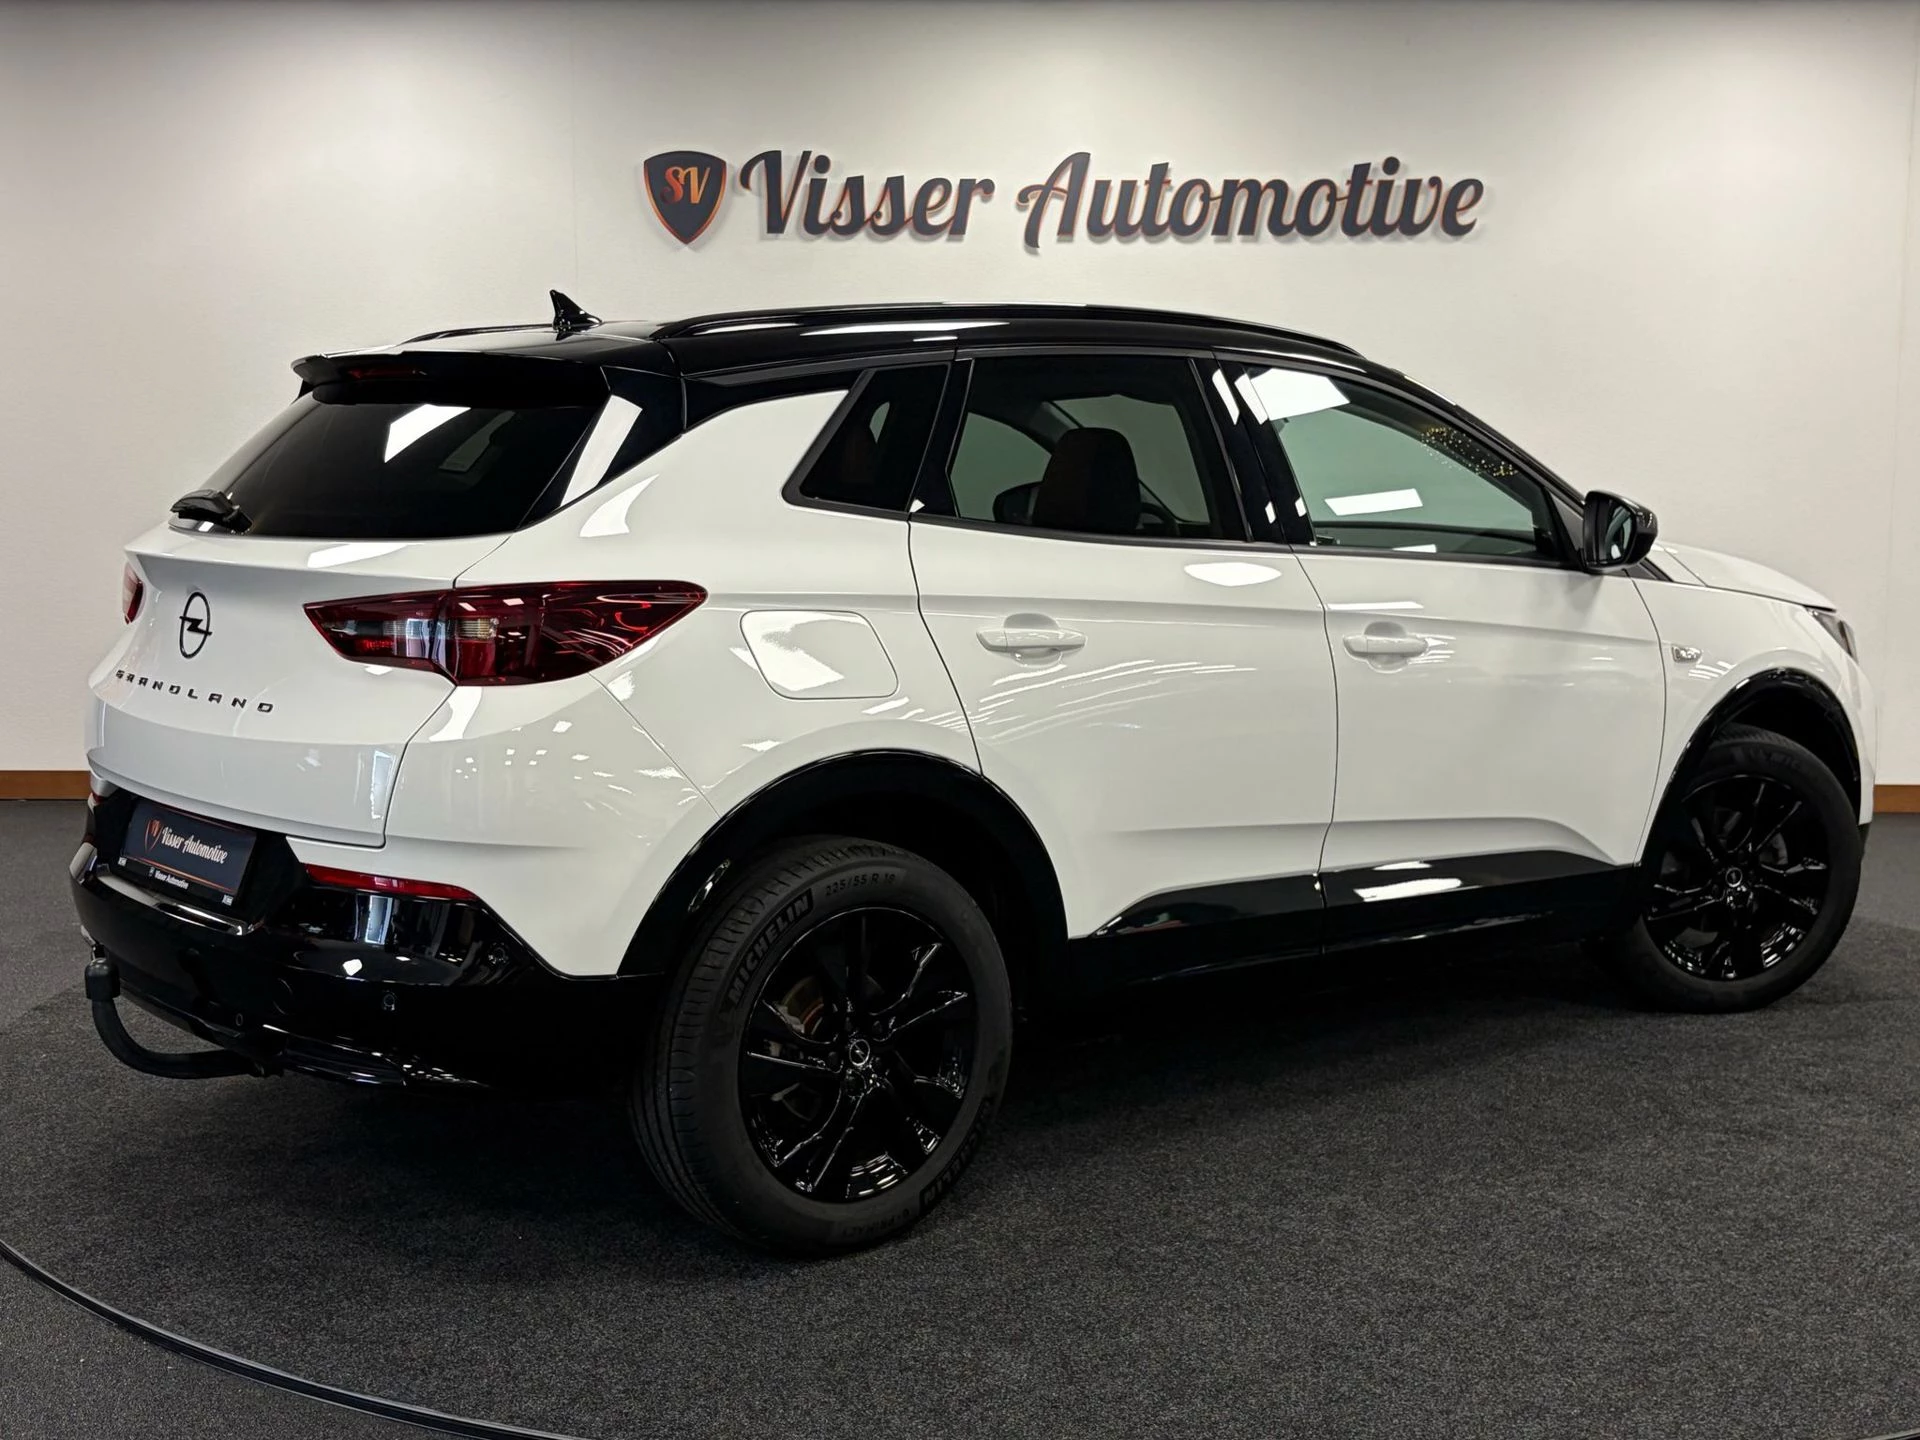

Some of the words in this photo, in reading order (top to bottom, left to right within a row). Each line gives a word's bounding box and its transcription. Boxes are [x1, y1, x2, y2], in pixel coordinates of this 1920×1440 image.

[660, 165, 711, 204] SV
[739, 149, 994, 239] Visser
[1016, 151, 1485, 250] Automotive
[115, 668, 274, 713] GRANDLAND
[161, 826, 185, 850] Visser
[182, 834, 228, 864] Automotive
[154, 869, 168, 882] Visser
[166, 873, 189, 890] Automotive
[871, 872, 880, 885] R
[727, 886, 811, 1006] MICHELIN
